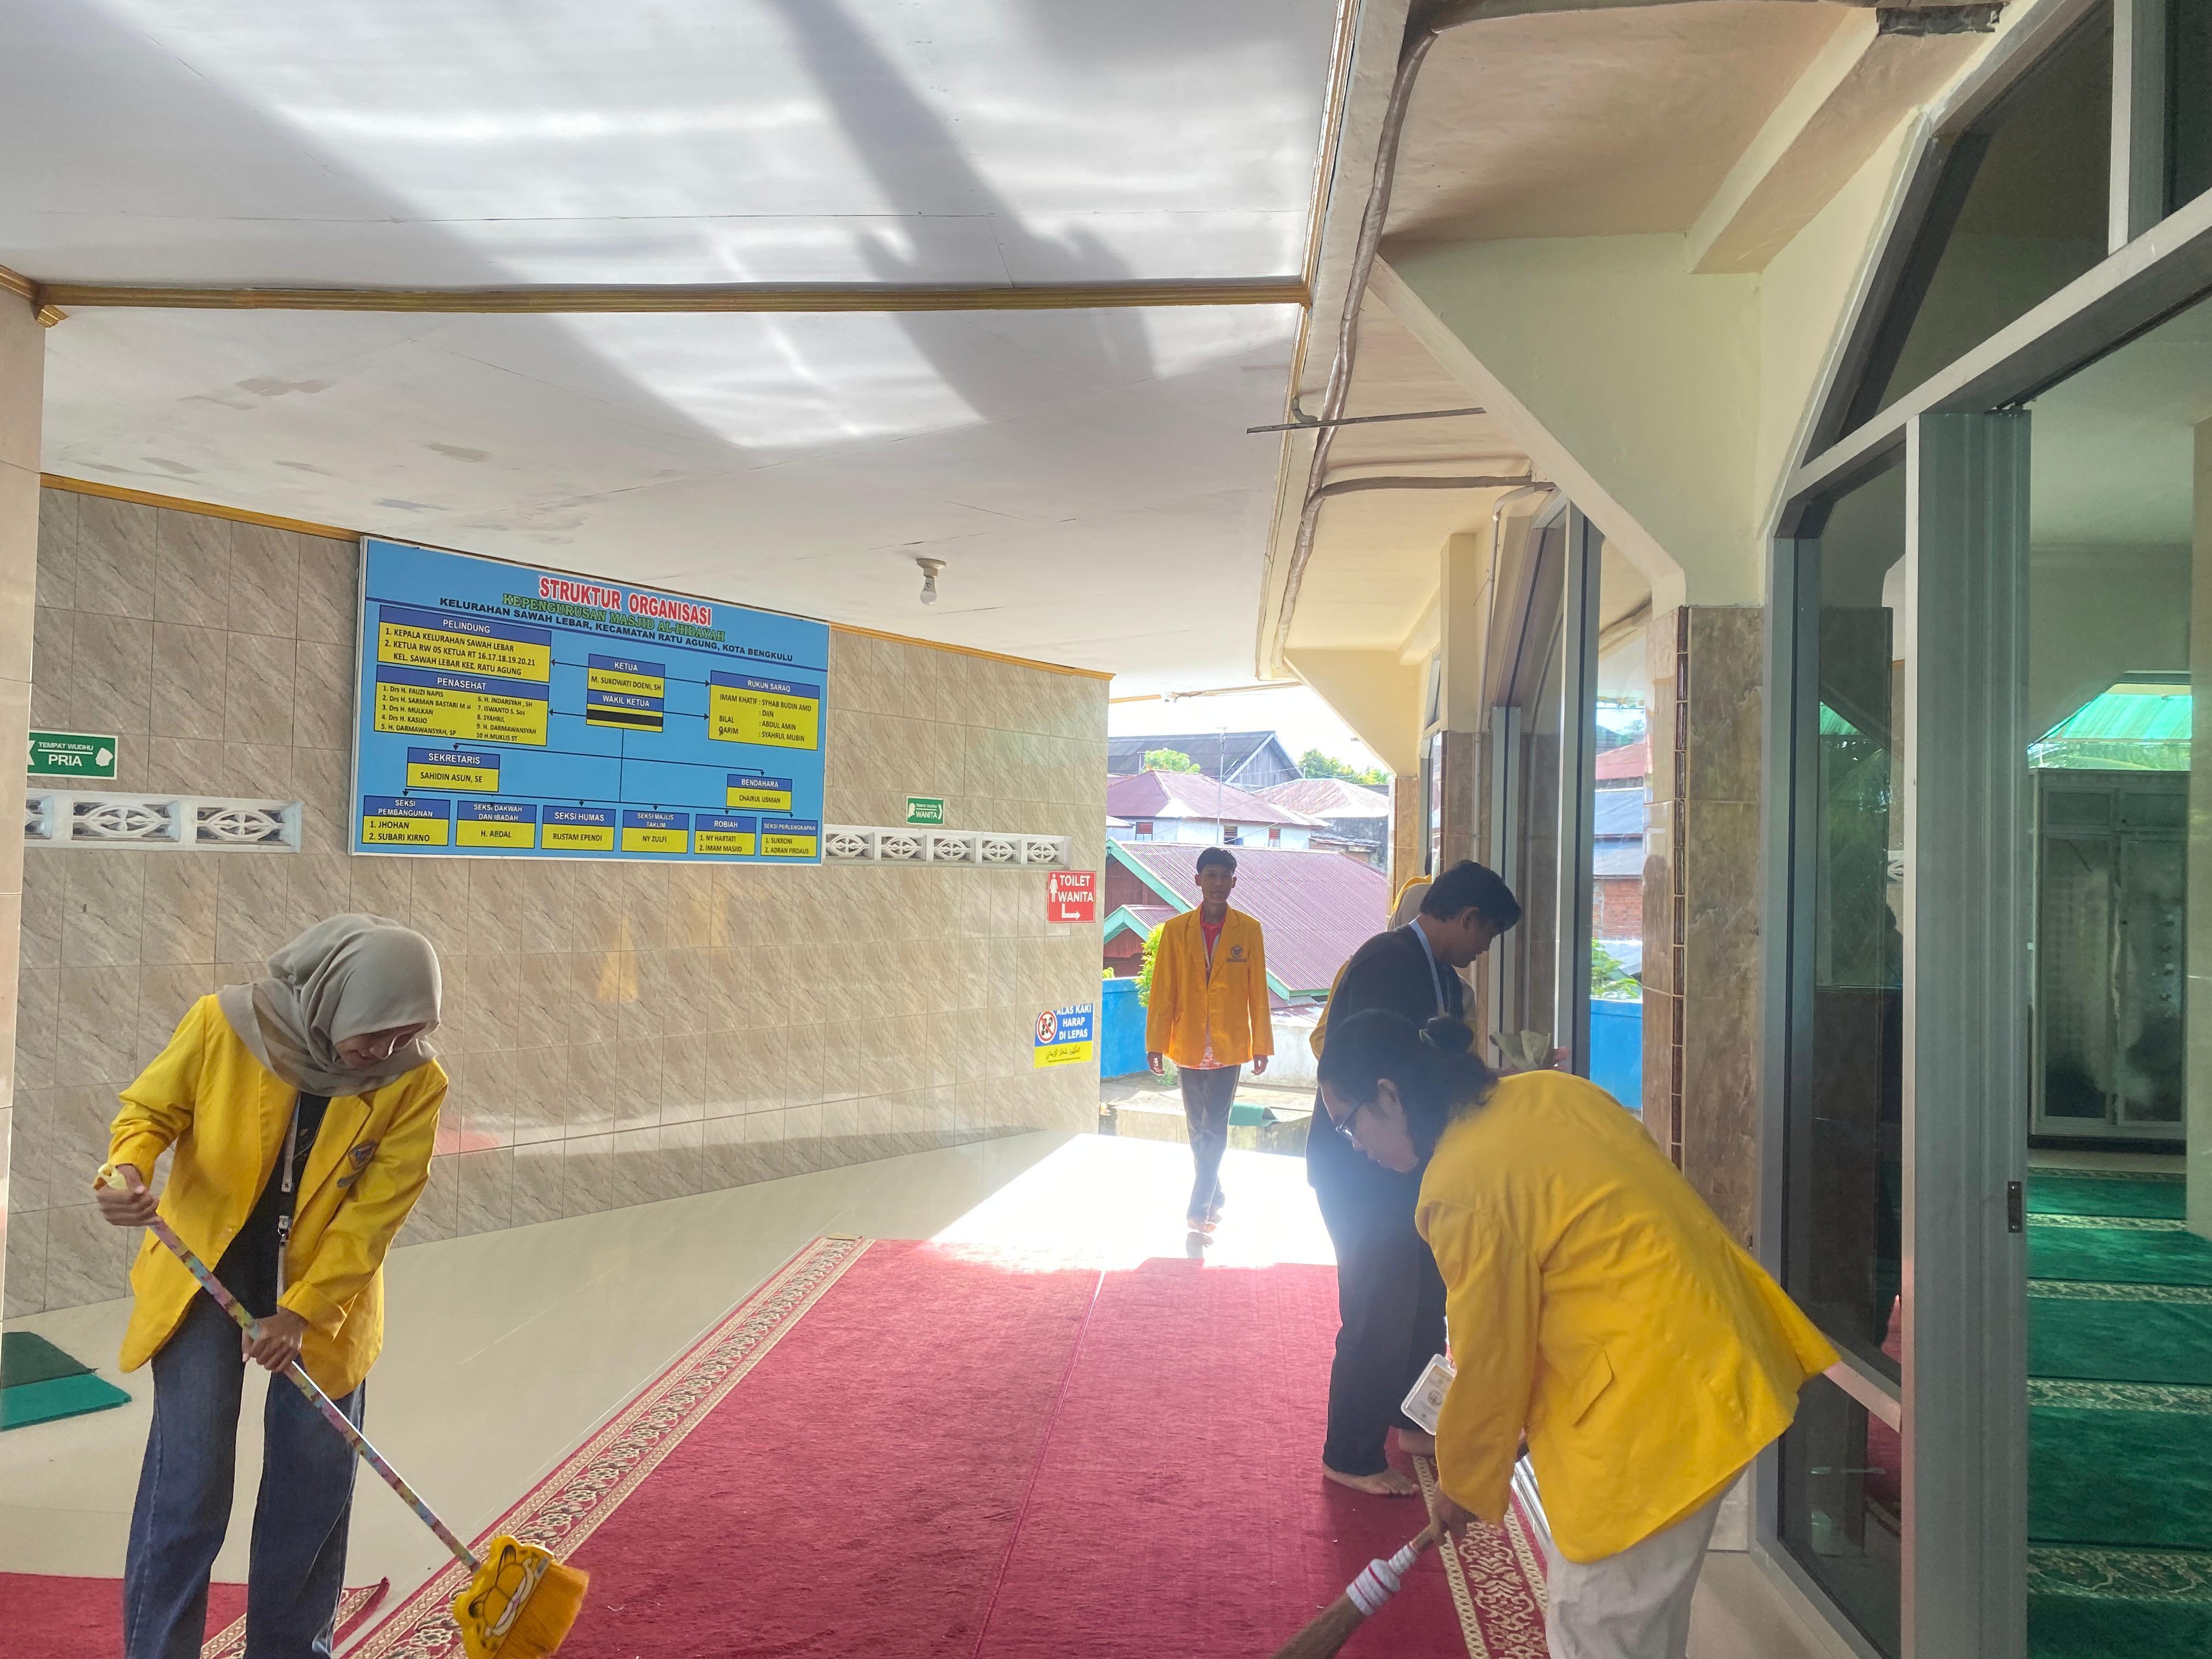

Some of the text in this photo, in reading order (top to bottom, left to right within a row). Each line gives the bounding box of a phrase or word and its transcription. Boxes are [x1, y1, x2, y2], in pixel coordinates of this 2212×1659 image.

[540, 577, 712, 626] STRUKTUR ORGANISASI
[503, 593, 725, 642] KEPENGURUSAN MASJID AL-HIDAYAH
[440, 597, 793, 661] KELURAHAN SAWAH LEBAR, KECAMATAN RATU AGUNG, KOTA BENGKULU
[443, 619, 490, 633] PELINDUNG
[394, 629, 421, 639] KEPALA
[422, 633, 465, 645] KELURAHAN
[466, 639, 492, 648] SAWAH
[493, 643, 514, 652] LEBAR
[393, 641, 417, 650] KETUA
[419, 644, 431, 652] RW
[443, 647, 466, 657] KETUA
[478, 652, 535, 666] 16.17.18.19.20.21
[393, 652, 408, 661] KEL.
[410, 654, 436, 664] SAWAH
[438, 658, 460, 668] LEBAR
[477, 664, 495, 672] RATU
[496, 666, 522, 675] AGUNG
[614, 661, 638, 672] KETUA
[437, 677, 487, 691] PENASEHAT
[601, 678, 631, 687] SUKOWATI
[748, 680, 791, 693] RUKUN SARAQ
[408, 697, 434, 706] SARMAN
[602, 695, 650, 707] WAKIL KETUA
[720, 693, 737, 703] IMAM
[739, 696, 758, 705] KHATIF
[762, 699, 780, 708] SYHAB
[781, 701, 798, 710] BUDIN
[408, 707, 433, 715] MULKAN
[484, 706, 509, 714] ISWANTO
[719, 715, 734, 723] BILAL
[762, 720, 780, 729] ABDUL
[490, 725, 536, 734] DARMAWANSYAH
[762, 731, 785, 740] SYAHRUL
[787, 733, 805, 742] MUBIN
[48, 754, 82, 766] PRIA
[428, 753, 480, 765] SEKRETARIS
[420, 772, 449, 781] SAHIDIN
[452, 775, 473, 783] ASUN,
[741, 779, 778, 788] BENDAHARA
[378, 808, 433, 817] PEMBANGUNAN
[554, 812, 605, 822] SEKSI HUMAS
[916, 810, 938, 819] WANITA
[378, 821, 409, 829] JHOHAN
[1059, 874, 1091, 887] TOILET
[1058, 891, 1094, 902] WANITA
[1057, 1005, 1092, 1015] ALAS KAKI
[1063, 1017, 1085, 1028] HARAP
[1059, 1029, 1088, 1040] DI LEPAS
